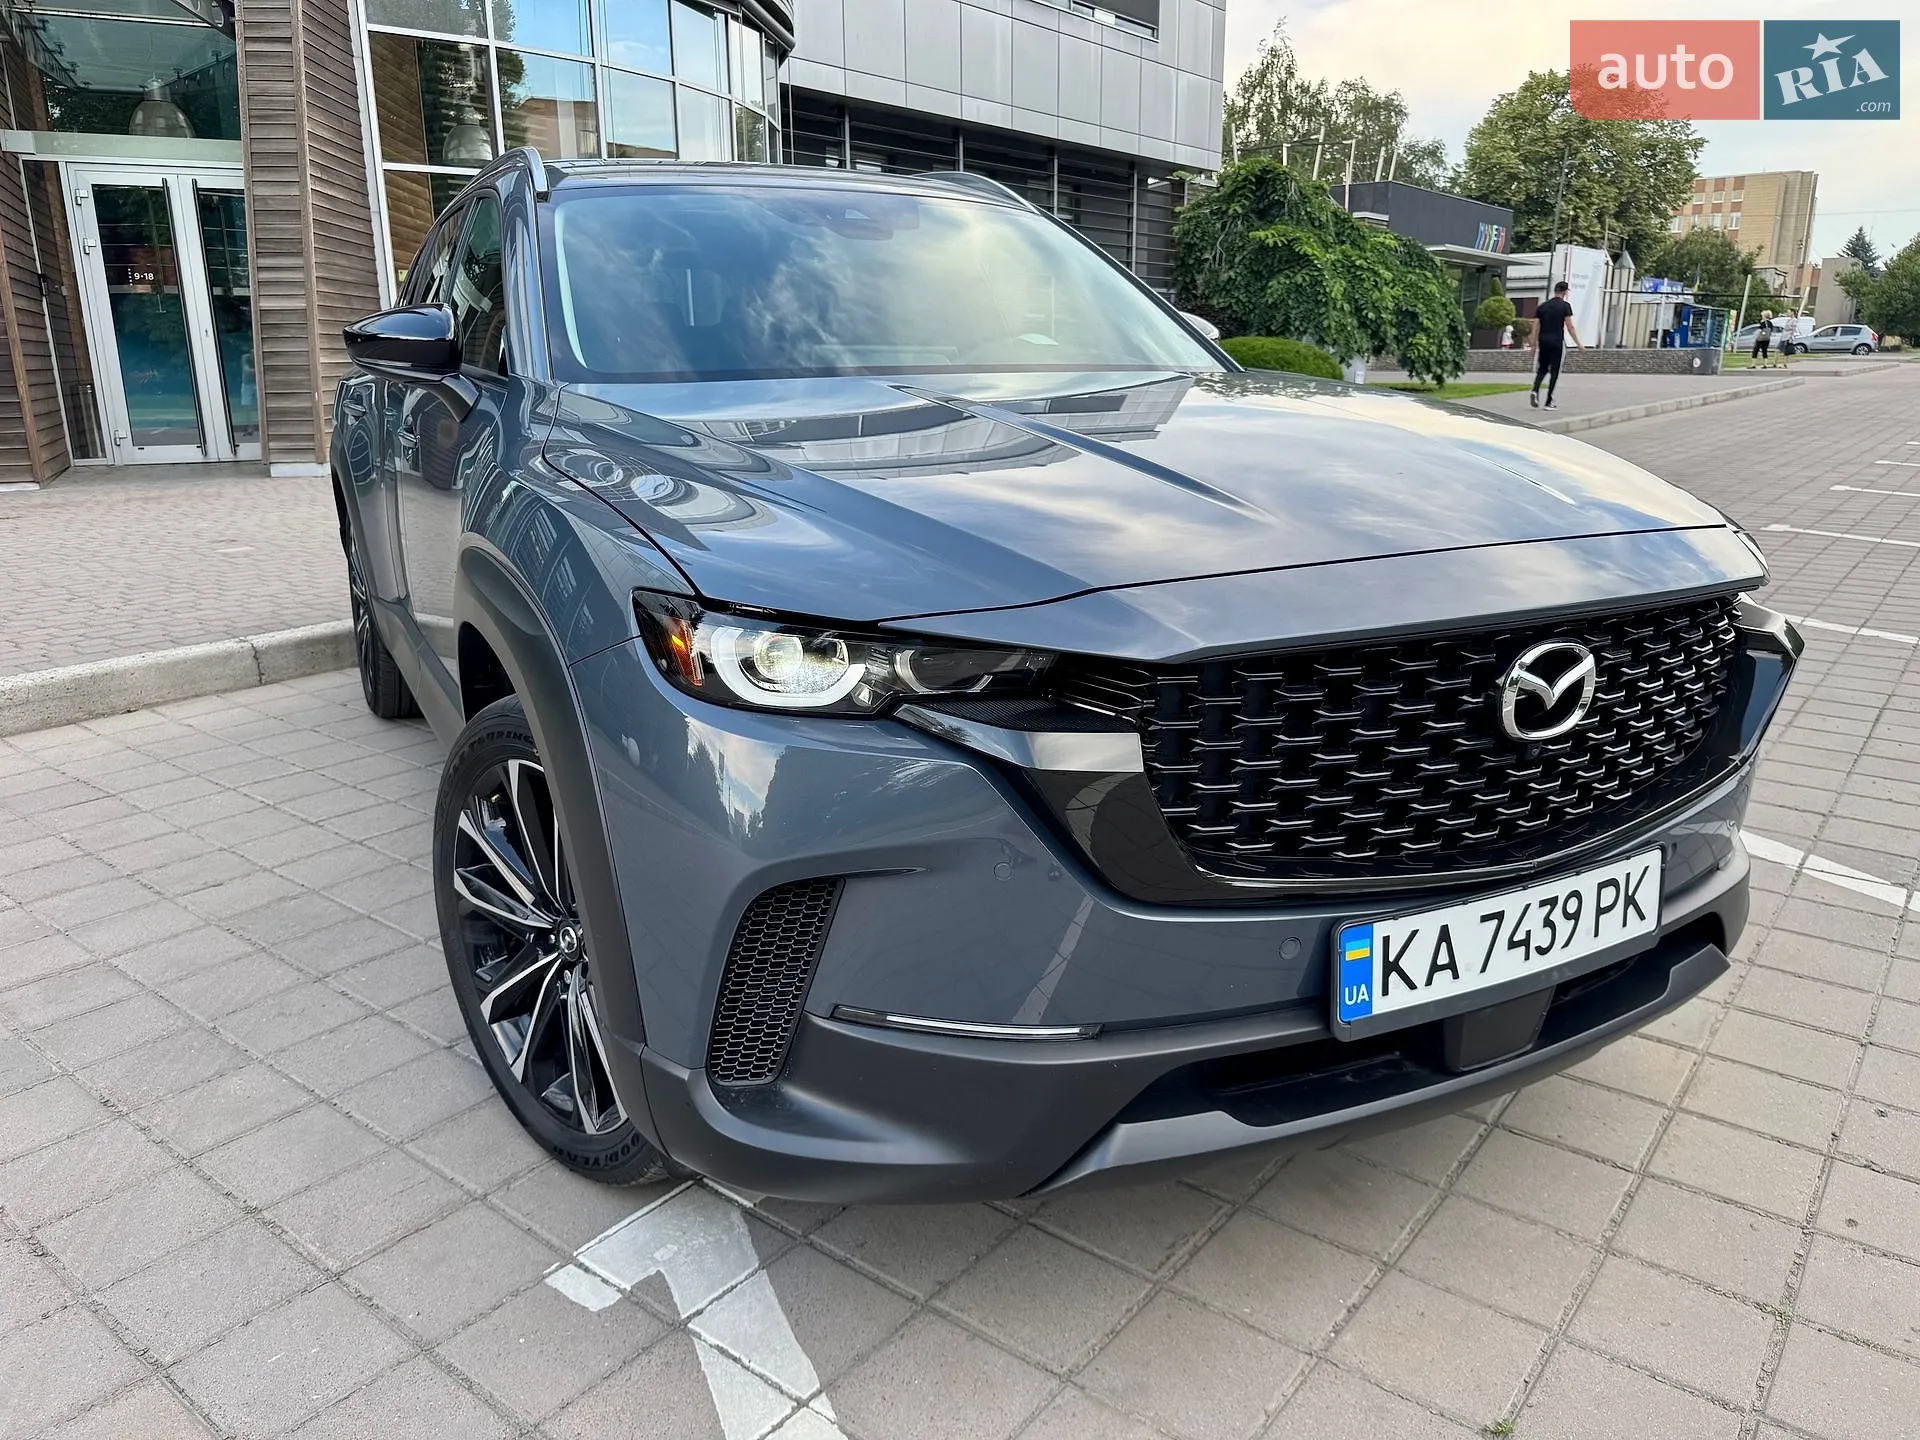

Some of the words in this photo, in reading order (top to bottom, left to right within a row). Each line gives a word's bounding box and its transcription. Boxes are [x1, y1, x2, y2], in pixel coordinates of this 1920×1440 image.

[1382, 924, 1460, 996] KA
[1479, 890, 1583, 973] 7439
[1594, 865, 1650, 938] PK
[1345, 984, 1369, 1005] UA
